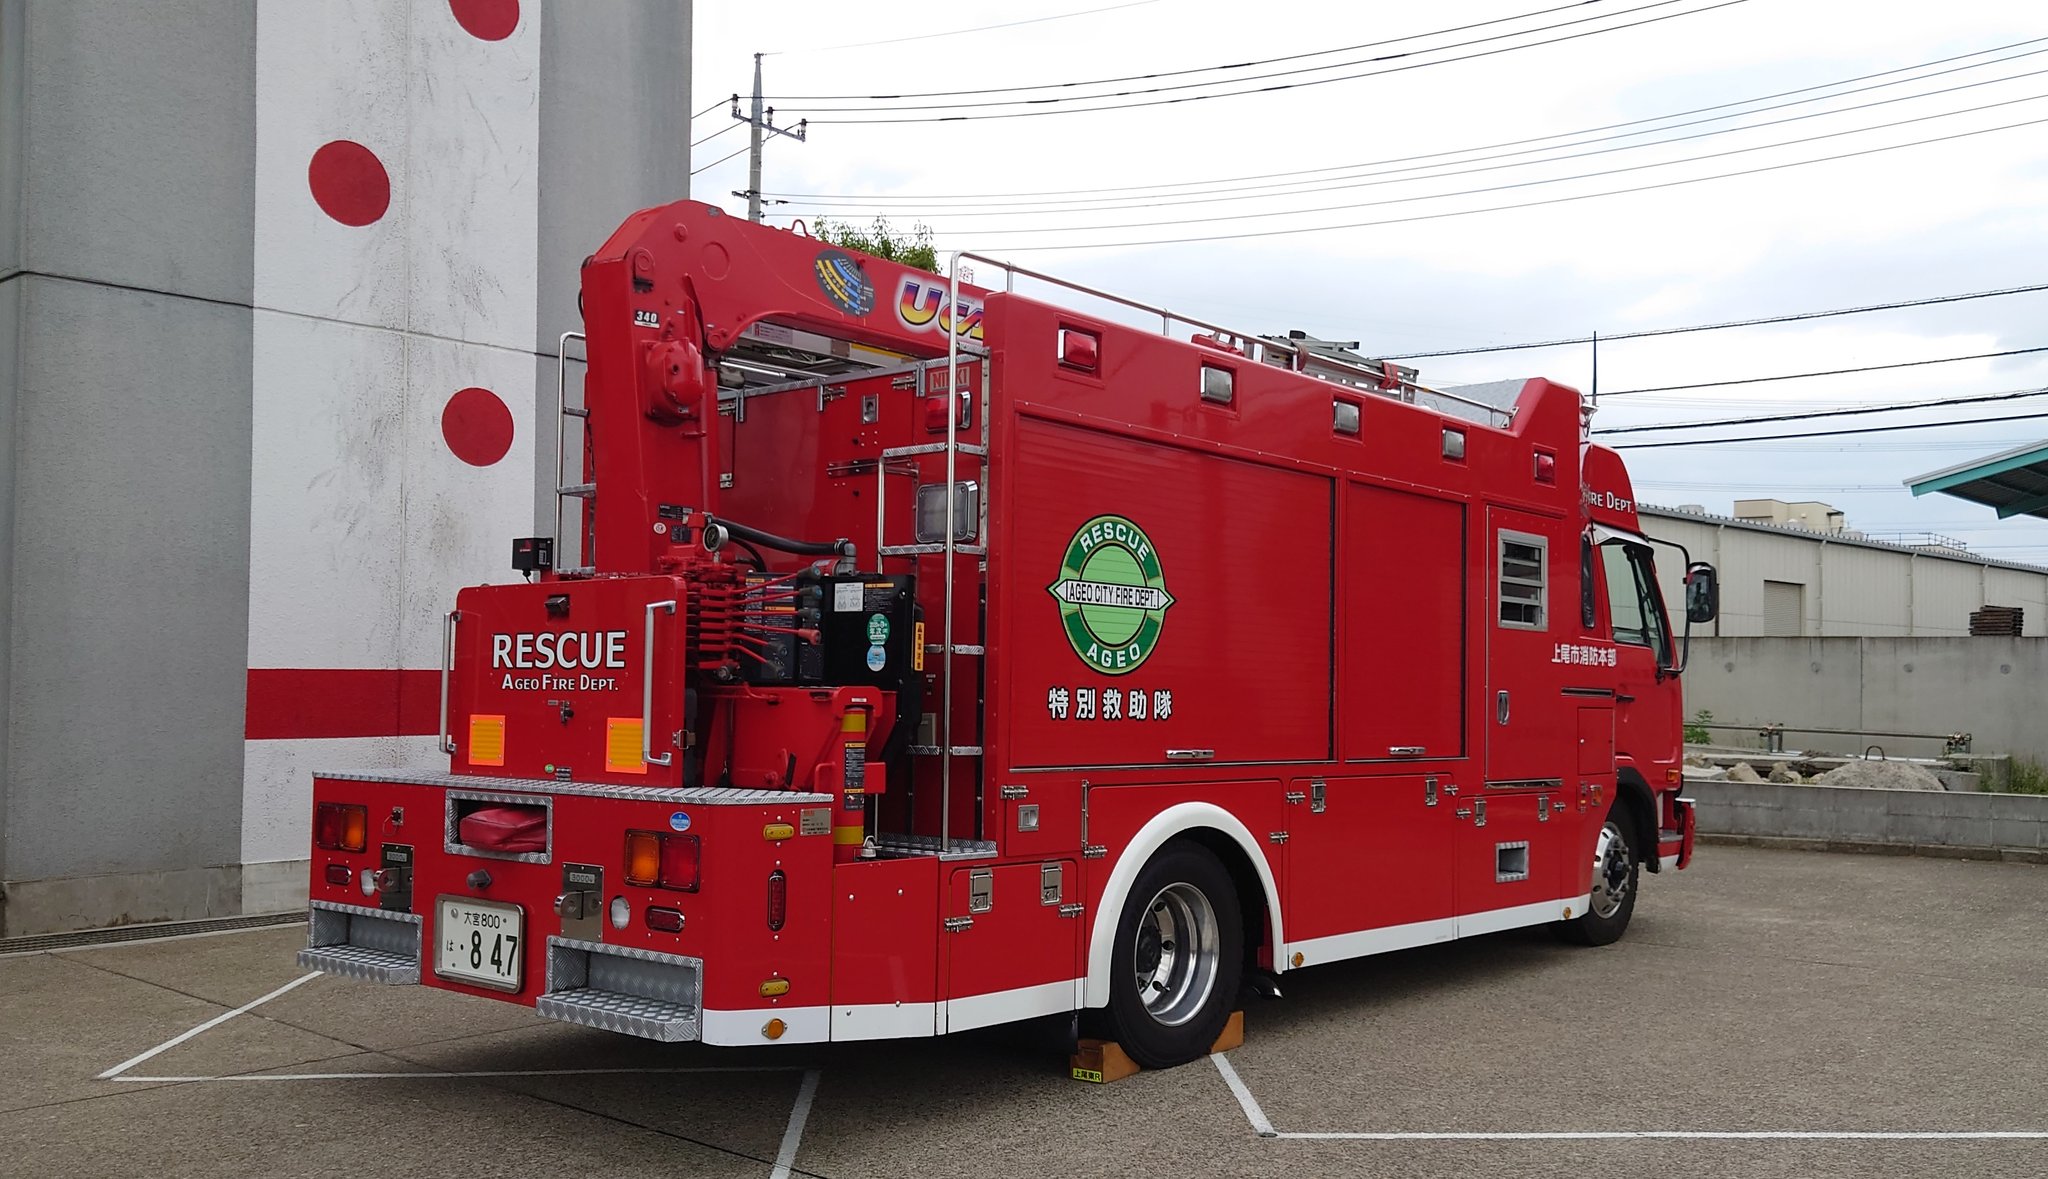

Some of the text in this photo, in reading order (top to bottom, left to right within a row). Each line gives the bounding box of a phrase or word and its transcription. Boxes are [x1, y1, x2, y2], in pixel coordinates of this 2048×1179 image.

[636, 311, 657, 323] 340
[932, 367, 968, 389] NIKI
[1606, 491, 1635, 514] DEPT.
[1080, 522, 1150, 562] RESCUE
[1069, 582, 1157, 608] AGEO CITY FIRE DEPT.
[492, 631, 627, 669] RESCUE
[1086, 642, 1141, 668] AGEO
[1551, 642, 1617, 668] 上尾市消防本部
[501, 673, 619, 691] AGEO FIRE DEPT.
[1048, 687, 1173, 720] 特別救助隊
[463, 910, 501, 929] 大宮800
